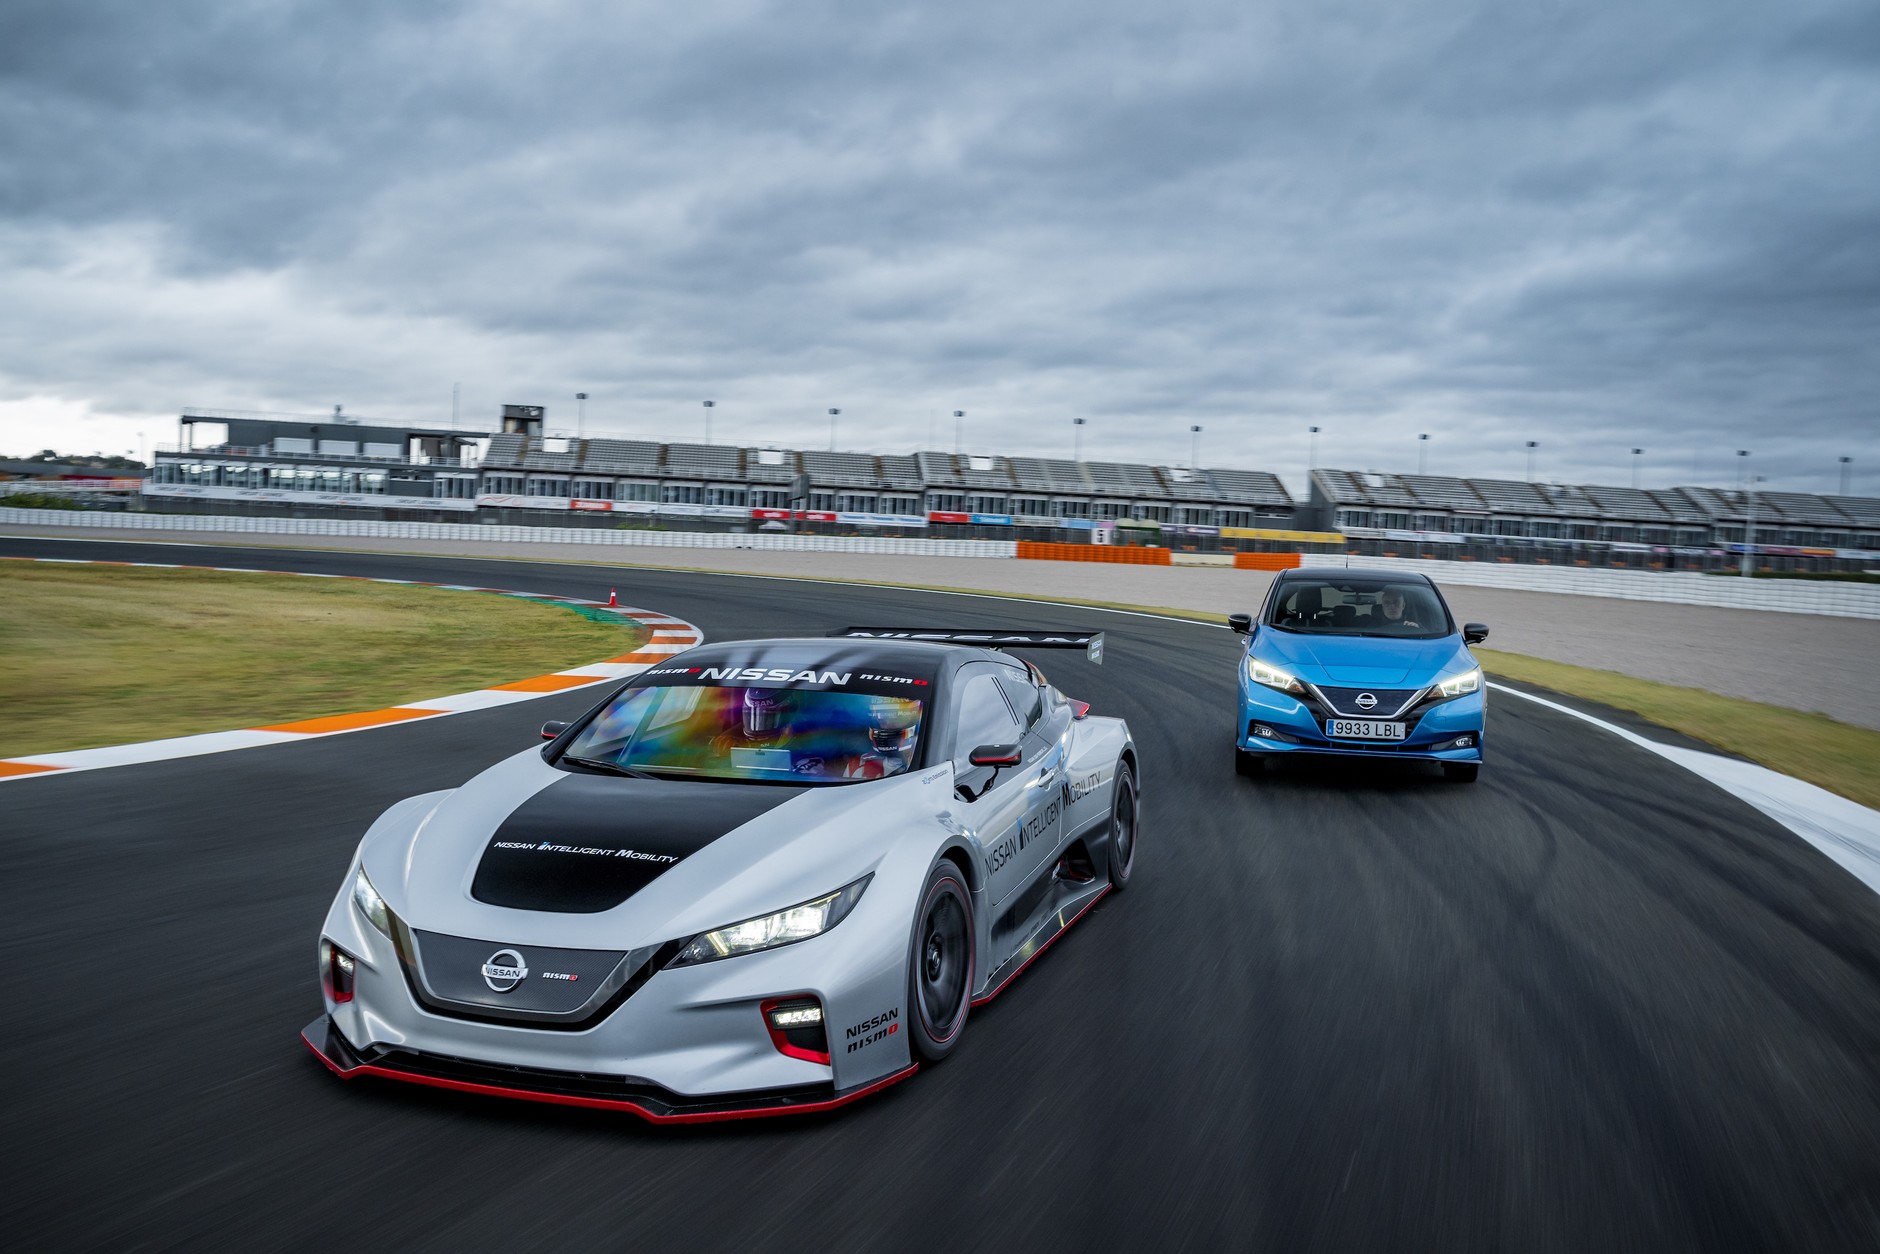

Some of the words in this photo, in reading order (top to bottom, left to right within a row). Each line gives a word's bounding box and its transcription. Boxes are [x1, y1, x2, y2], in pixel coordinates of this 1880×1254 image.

[697, 667, 852, 685] NISSAN
[859, 673, 928, 686] nismo
[1335, 722, 1370, 735] 9933
[1375, 723, 1401, 737] LBL
[984, 835, 1017, 880] NISSAN
[1017, 816, 1062, 851] INTELLIGENT
[1061, 771, 1101, 811] MOBILITY
[494, 841, 537, 850] NISSAN
[536, 841, 615, 856] INTELLIGENT
[614, 849, 679, 864] MOBILITY
[485, 966, 520, 978] NISSAN
[542, 972, 578, 981] nismo
[846, 1007, 898, 1040] NISSAN
[847, 1023, 899, 1054] nismo
